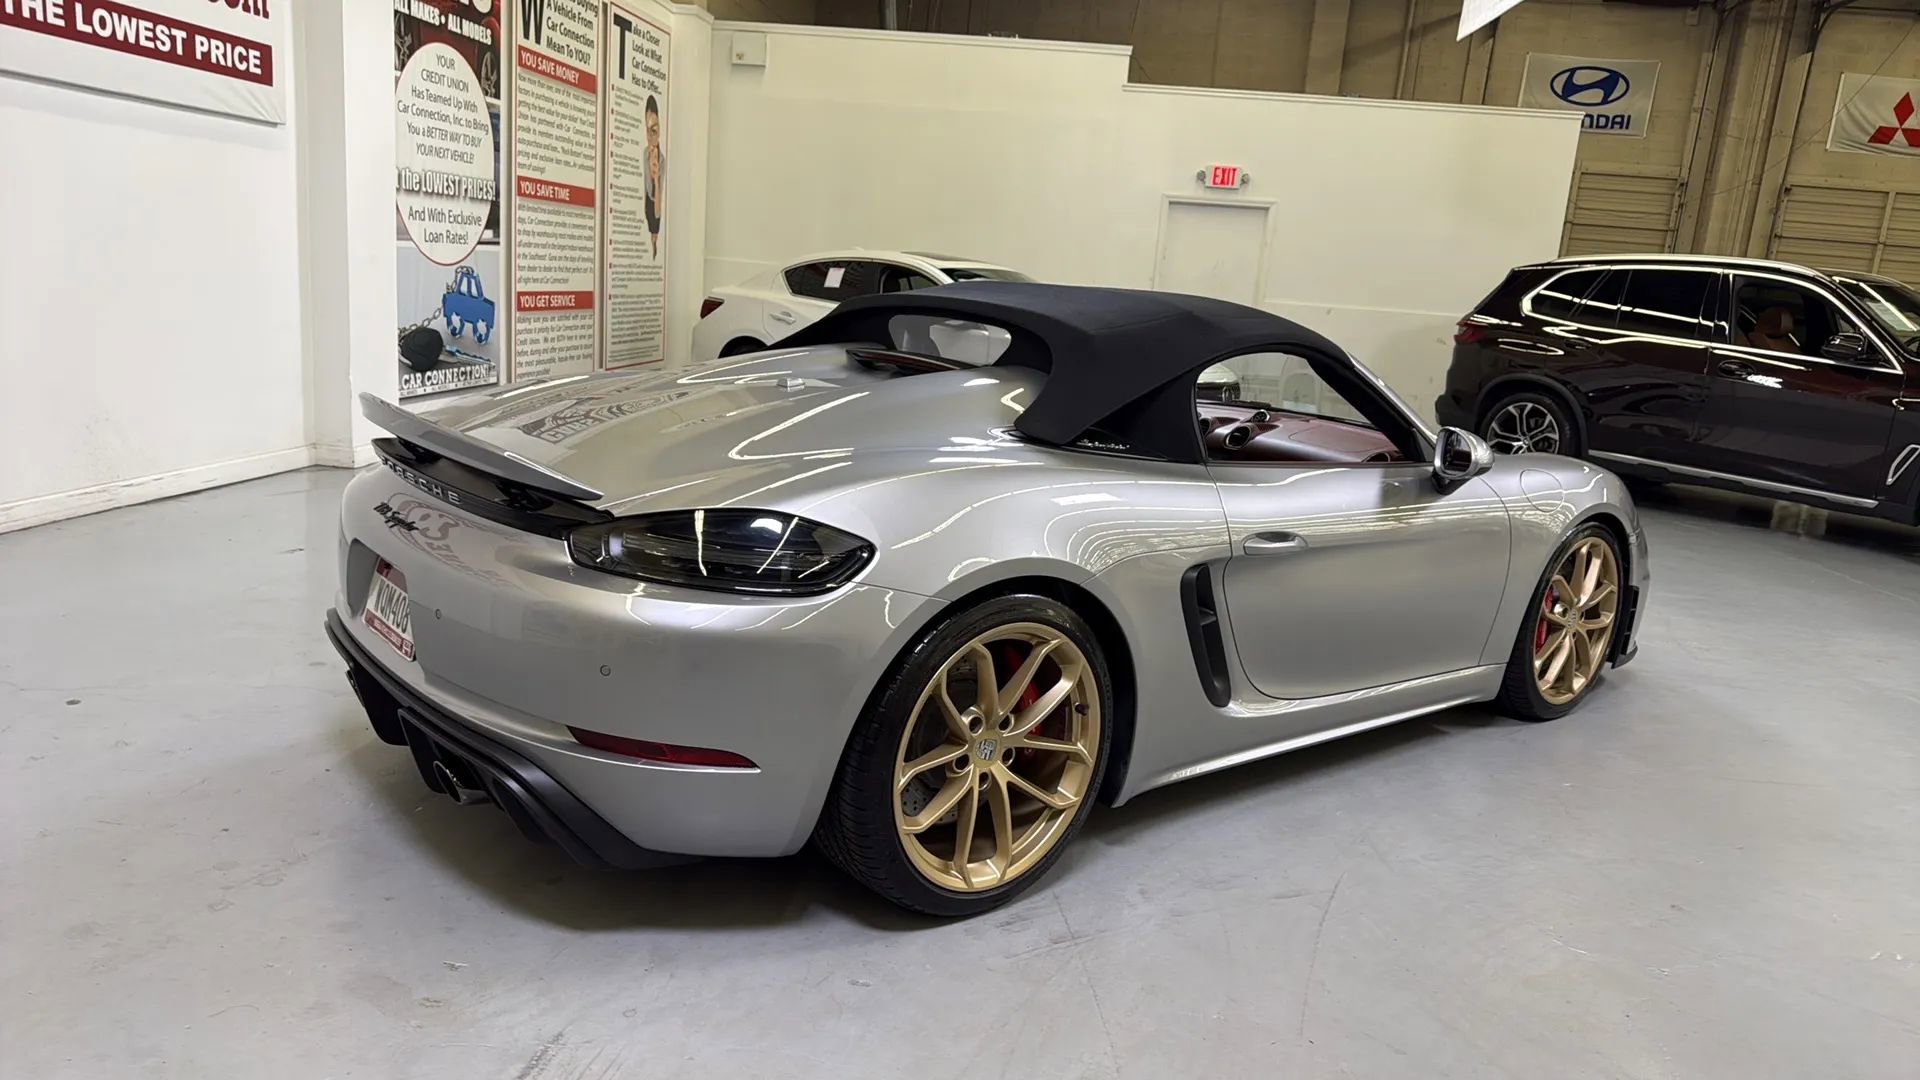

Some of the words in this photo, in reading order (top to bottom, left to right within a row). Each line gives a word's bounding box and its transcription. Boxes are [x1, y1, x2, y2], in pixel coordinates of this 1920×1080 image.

[394, 0, 409, 15] ALL
[410, 0, 440, 26] MAKES
[447, 13, 462, 34] ALL
[461, 18, 492, 45] MODELS
[552, 0, 577, 22] Vehicle
[577, 12, 594, 30] From
[74, 2, 187, 56] LOWEST
[195, 34, 262, 75] PRICE
[546, 16, 558, 32] Car
[559, 22, 595, 50] Connection
[546, 36, 565, 55] Mean
[565, 44, 573, 59] To
[436, 54, 456, 70] YOUR
[520, 50, 537, 68] YOU
[537, 57, 555, 75] SAVE
[555, 64, 579, 84] MONEY
[420, 68, 446, 87] CREDIT
[446, 76, 469, 93] UNION
[411, 85, 425, 99] Has
[425, 89, 452, 107] Teamed
[453, 96, 463, 110] Up
[463, 99, 478, 113] With
[397, 100, 410, 114] Car
[465, 118, 473, 129] to
[473, 119, 489, 135] Bring
[1580, 113, 1631, 130] NDAI
[407, 121, 421, 136] You
[426, 126, 449, 139] BETTER
[449, 131, 462, 144] WAY
[462, 135, 470, 147] TO
[416, 142, 433, 156] YOUR
[434, 146, 450, 159] NEXT
[401, 167, 420, 191] the
[421, 170, 460, 197] LOWEST
[461, 177, 496, 201] PRICES!
[1212, 166, 1237, 187] EXIT
[520, 181, 536, 196] YOU
[537, 183, 554, 198] SAVE
[554, 186, 570, 201] TIME
[408, 206, 425, 221] And
[427, 207, 446, 224] With
[448, 210, 482, 226] Exclusive
[424, 228, 444, 243] Loan
[446, 229, 469, 245] Rates!
[520, 295, 535, 308] YOU
[536, 294, 550, 308] GET
[550, 294, 576, 307] SERVICE
[402, 373, 422, 389] CAR
